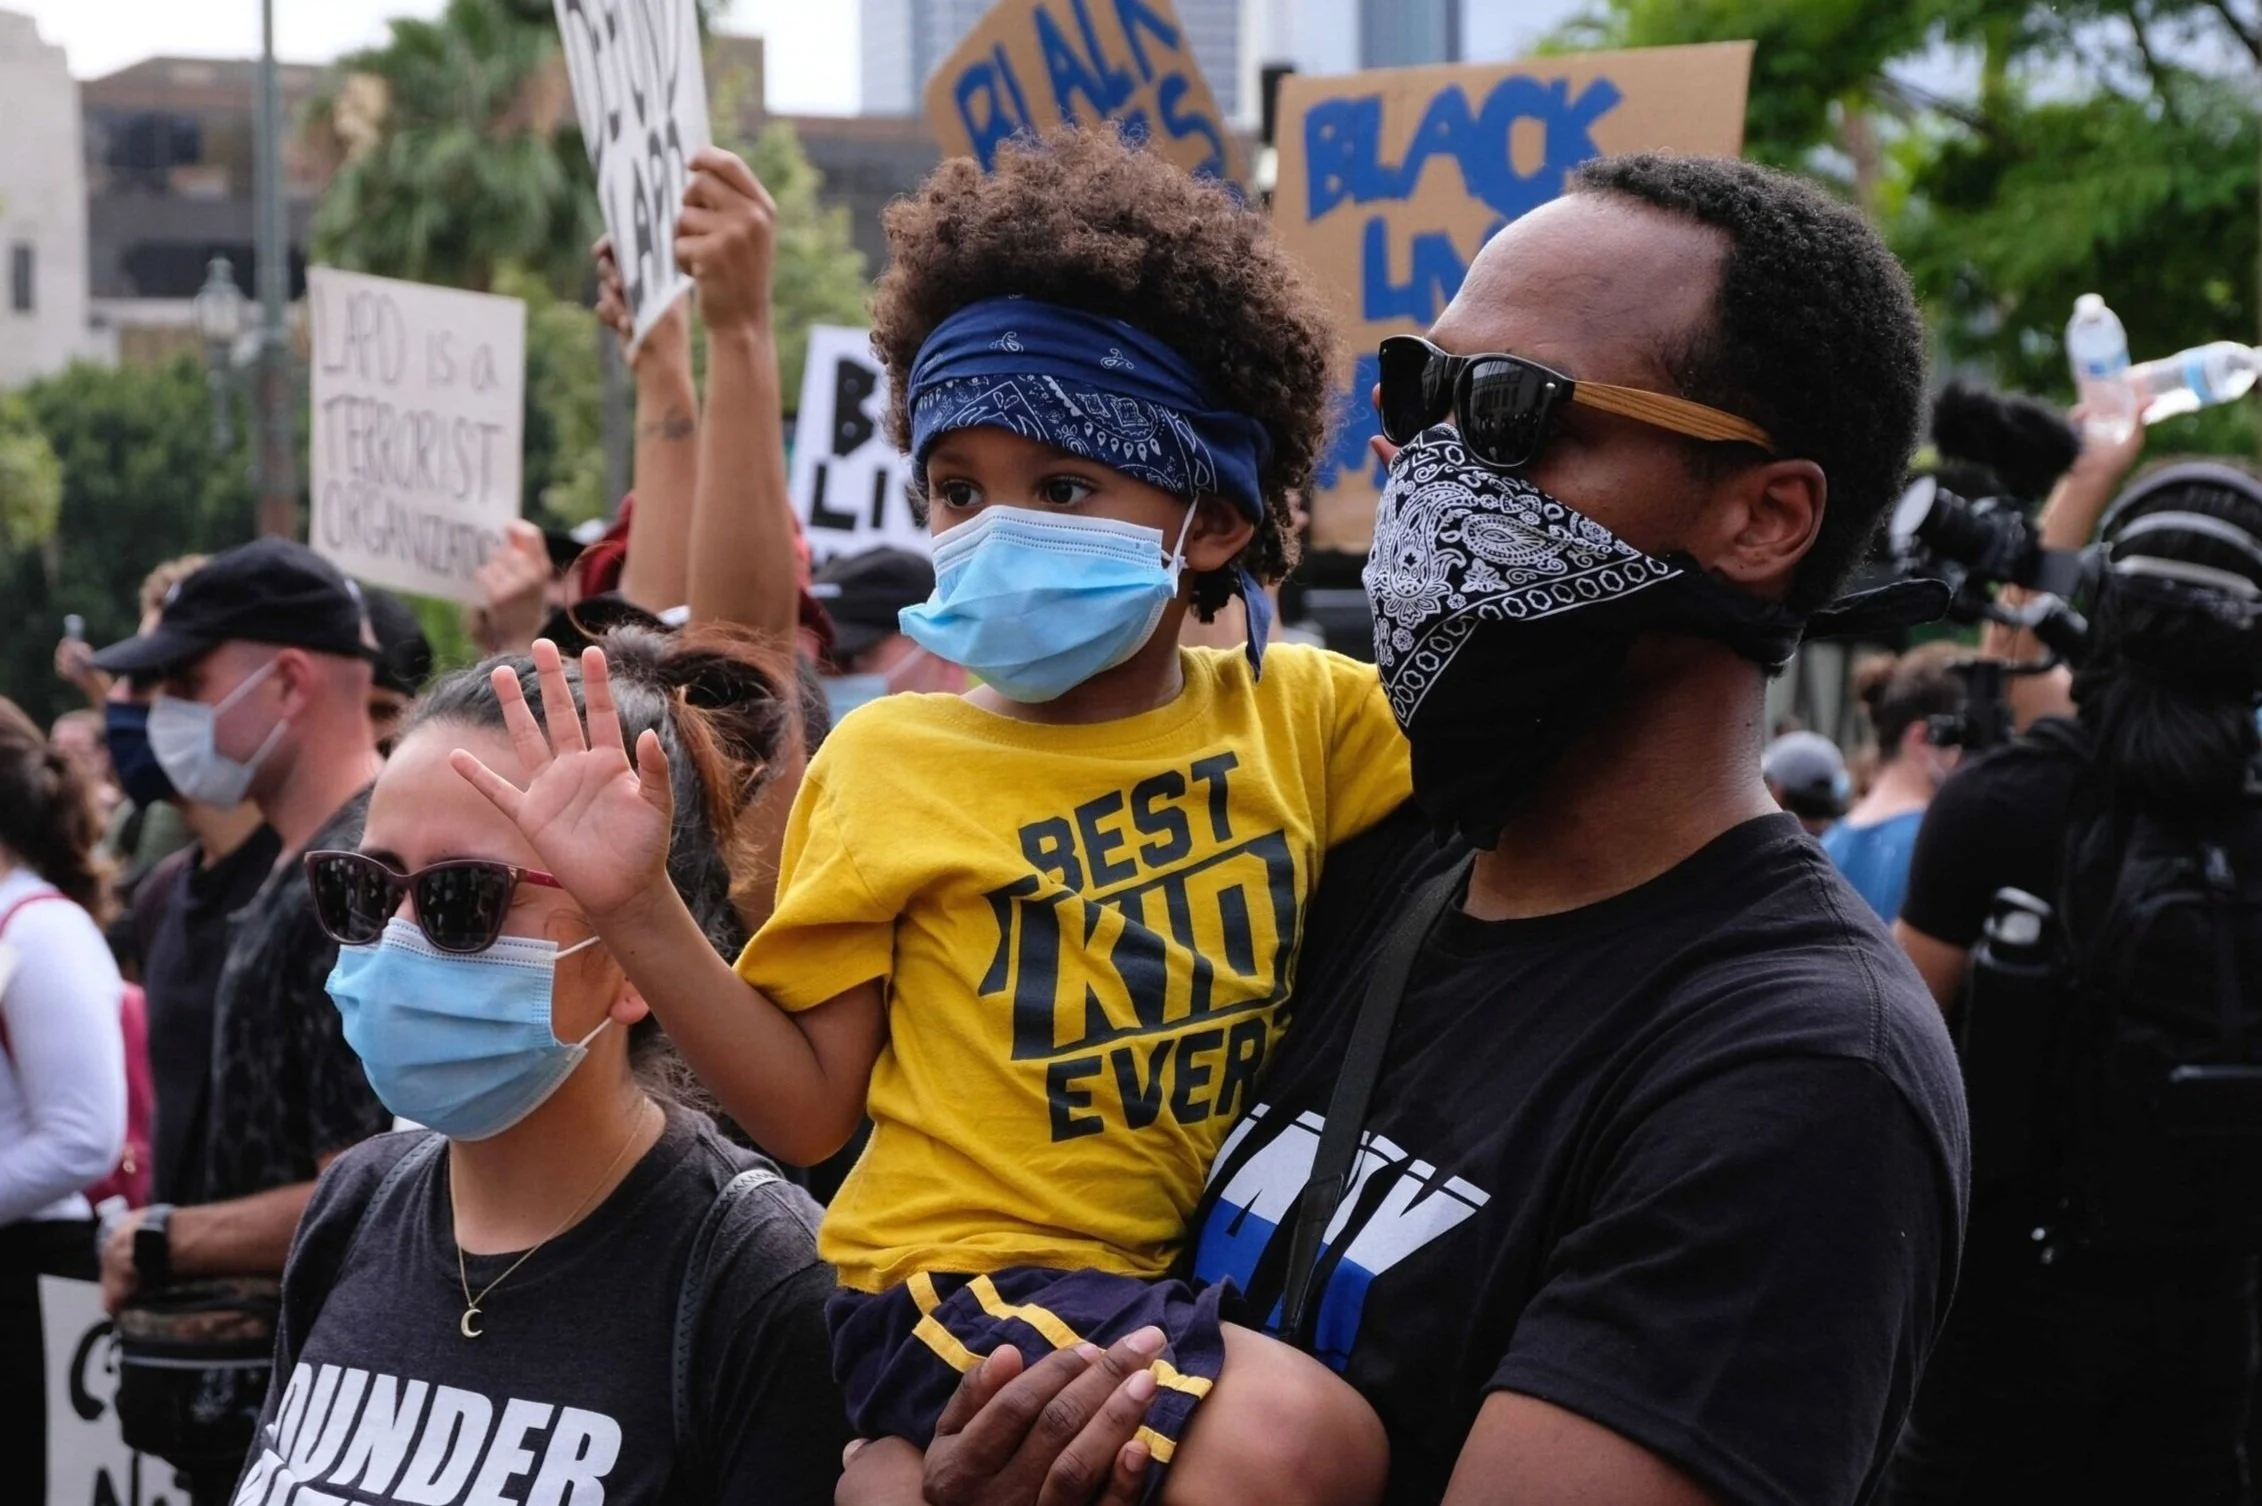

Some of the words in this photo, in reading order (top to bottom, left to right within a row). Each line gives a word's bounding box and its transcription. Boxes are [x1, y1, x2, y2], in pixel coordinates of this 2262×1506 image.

[1304, 74, 1625, 222] BLACK
[313, 282, 406, 387] LAPD
[323, 394, 505, 504] TERRORIST
[1018, 751, 1239, 897] BEST
[990, 830, 1298, 1060] KID
[1046, 1016, 1268, 1143] EVER
